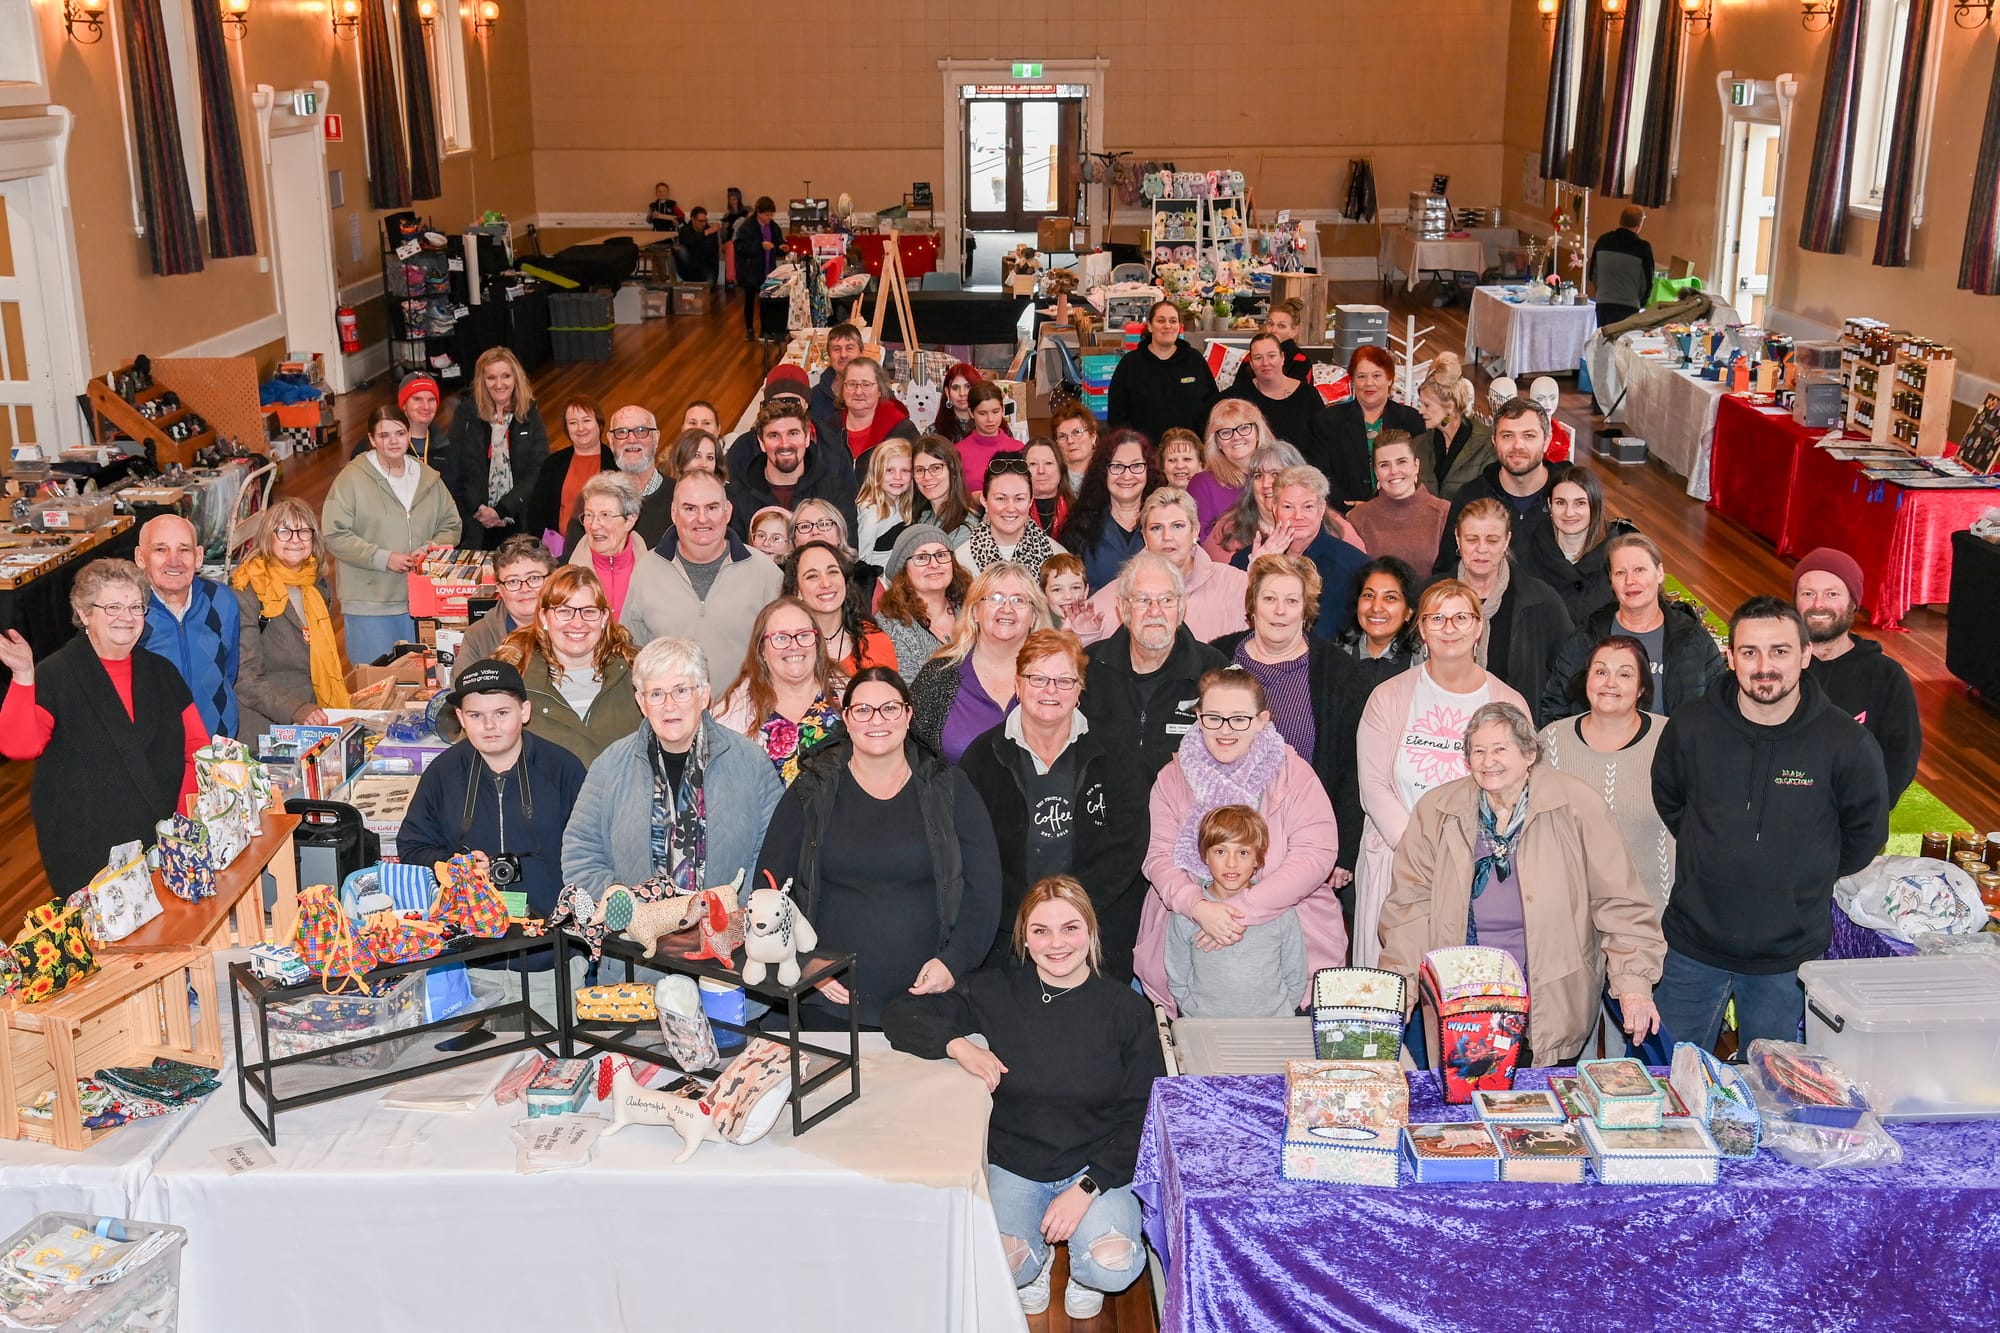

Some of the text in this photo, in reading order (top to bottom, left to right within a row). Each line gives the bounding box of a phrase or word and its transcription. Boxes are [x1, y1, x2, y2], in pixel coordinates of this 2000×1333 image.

[278, 733, 295, 741] Ted
[1406, 735, 1450, 749] Eternal
[625, 1096, 666, 1112] Autograph
